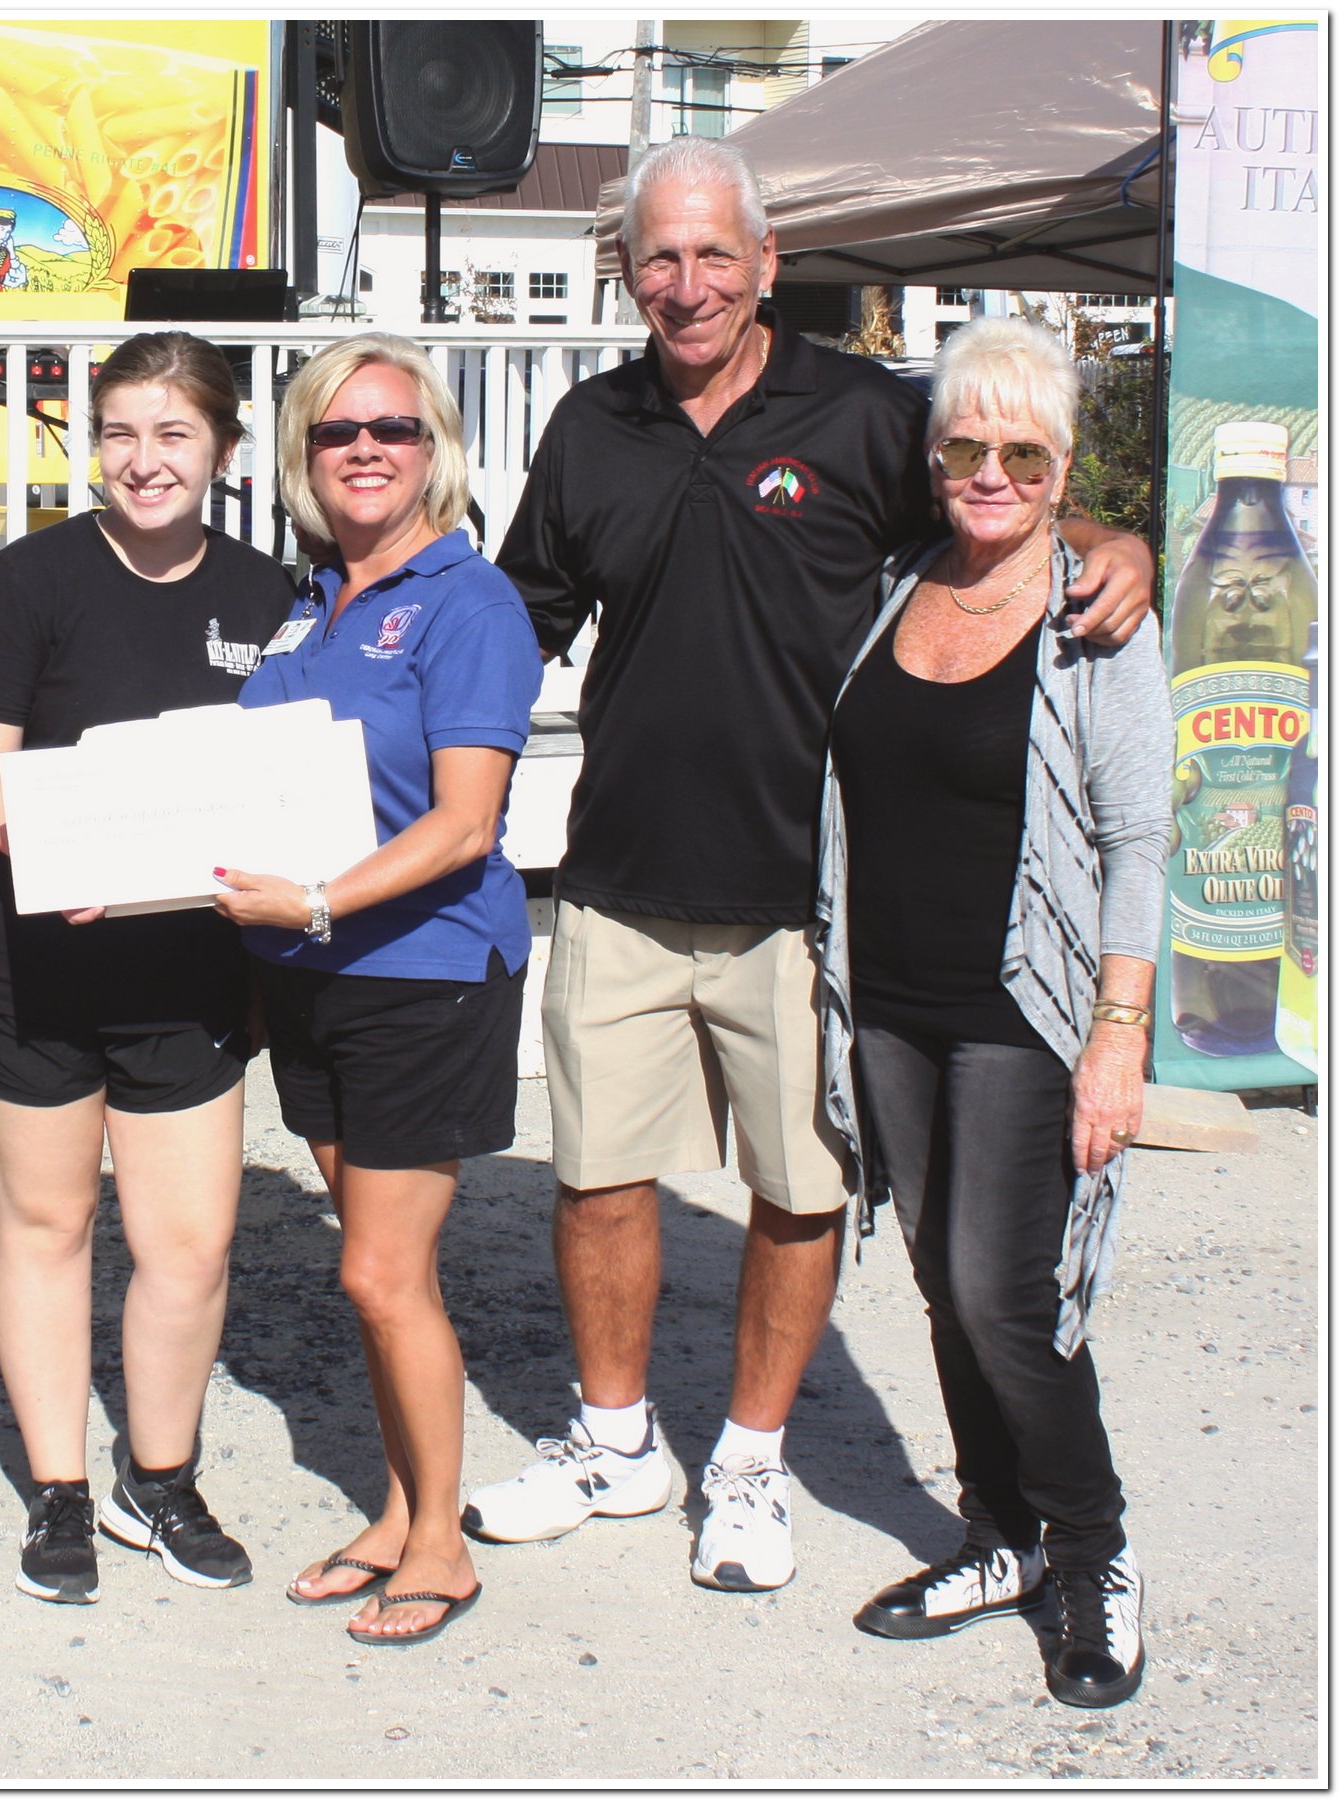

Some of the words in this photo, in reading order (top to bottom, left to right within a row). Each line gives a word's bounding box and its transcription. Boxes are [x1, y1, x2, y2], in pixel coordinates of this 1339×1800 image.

[33, 143, 84, 161] PENNE
[1192, 706, 1301, 743] CENTO
[1184, 848, 1241, 875] EXTRA
[1203, 876, 1255, 905] OLIVE
[1201, 931, 1211, 942] FL
